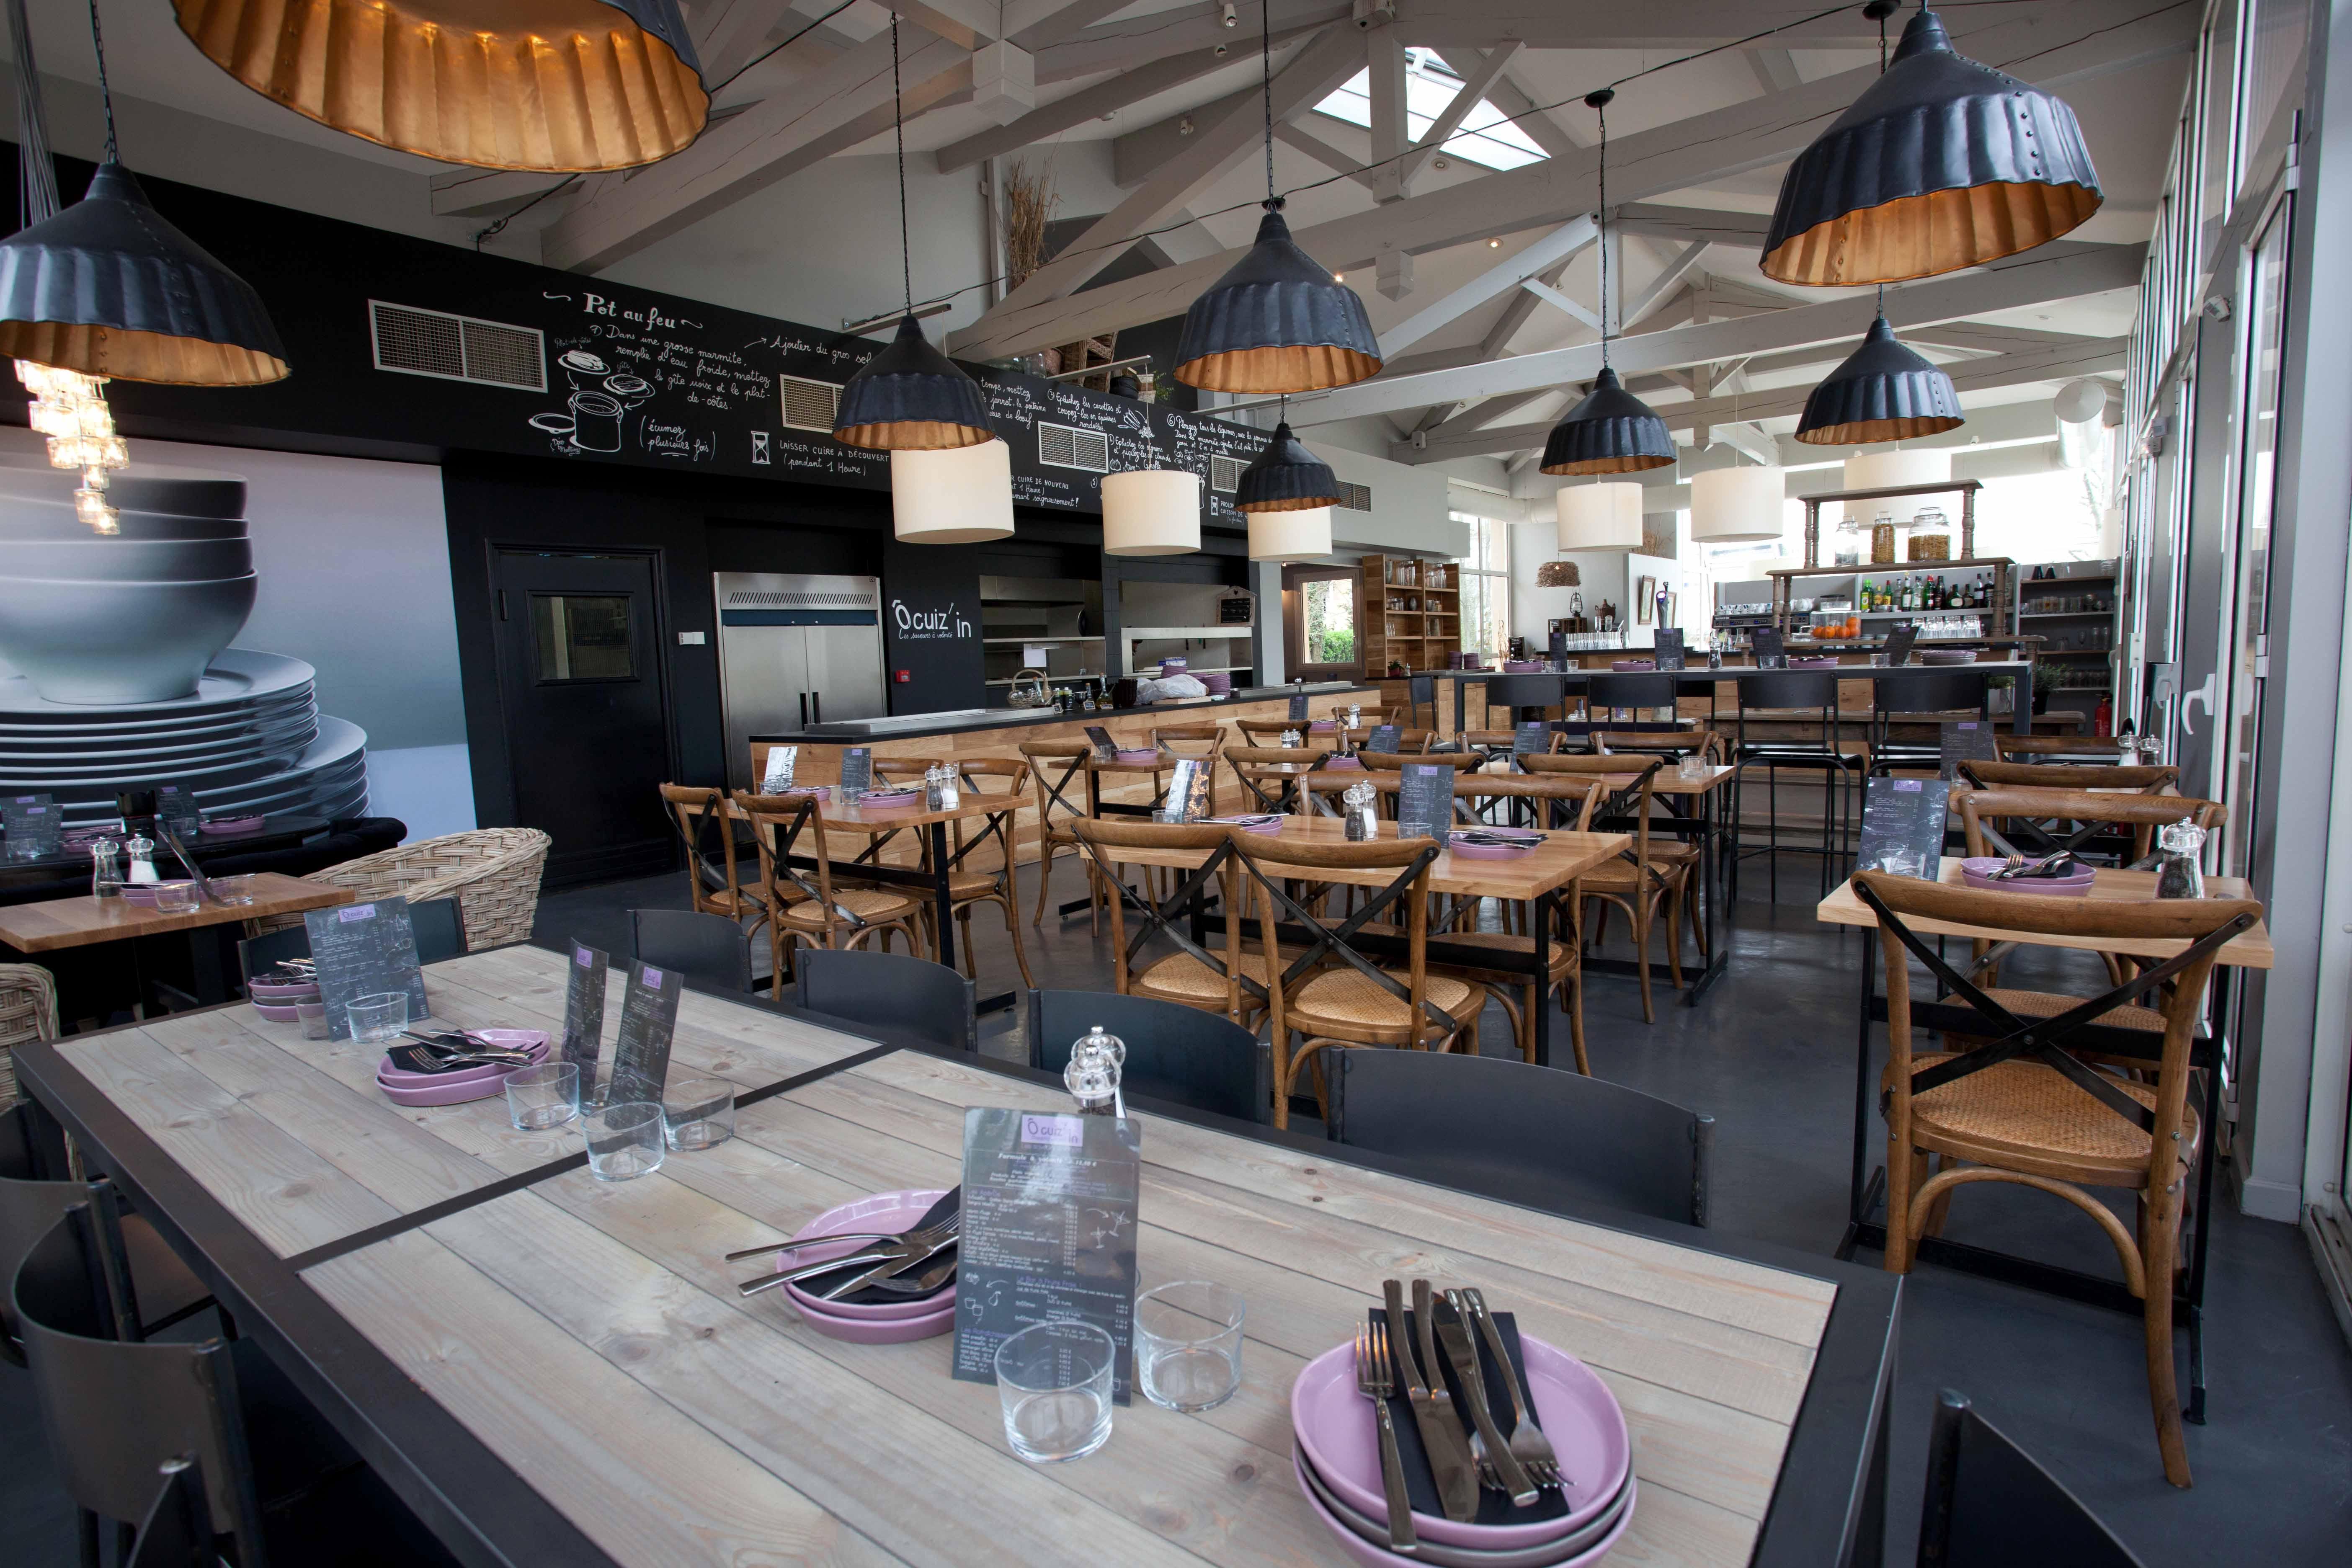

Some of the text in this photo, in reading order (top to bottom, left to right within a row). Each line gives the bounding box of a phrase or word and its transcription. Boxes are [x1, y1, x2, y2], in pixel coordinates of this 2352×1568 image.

[583, 293, 676, 331] Pot au feu
[606, 325, 635, 340] Dans
[640, 336, 660, 346] une
[664, 341, 694, 358] grosse
[770, 335, 872, 364] Ajouter du gros sel
[616, 346, 771, 389] remplie d'eau froide, mettez
[655, 369, 664, 382] le
[668, 374, 685, 390] gîte
[717, 383, 725, 393] et
[731, 383, 739, 395] le
[744, 386, 771, 401] plat-
[1006, 385, 1031, 402] mettez
[1016, 398, 1022, 408] la
[1025, 401, 1047, 413] poitrine
[1056, 392, 1080, 410] Epluchez
[1093, 402, 1114, 412] carottes
[1115, 404, 1122, 414] et
[1006, 410, 1013, 419] de
[1057, 407, 1089, 422] coupez-les
[1098, 413, 1116, 425] épaisses
[1079, 421, 1106, 431] rondelles.
[1176, 415, 1198, 436] Plongez
[1199, 420, 1209, 432] tous
[1253, 436, 1267, 445] pommes
[647, 438, 690, 451] plusieurs
[1115, 436, 1137, 451] Epluchez
[1147, 442, 1163, 453] oignons
[1174, 429, 1186, 439] Dans
[1220, 440, 1233, 450] ajouter
[780, 440, 809, 452] LAISSER
[812, 446, 835, 456] CUIRE
[848, 449, 890, 462] DÉCOUVERT
[1114, 446, 1119, 454] et
[1122, 448, 1147, 462] piquez-les
[1165, 454, 1171, 462] de
[827, 462, 833, 472] 1
[1044, 480, 1069, 490] NOUVEAU
[899, 628, 909, 639] Les
